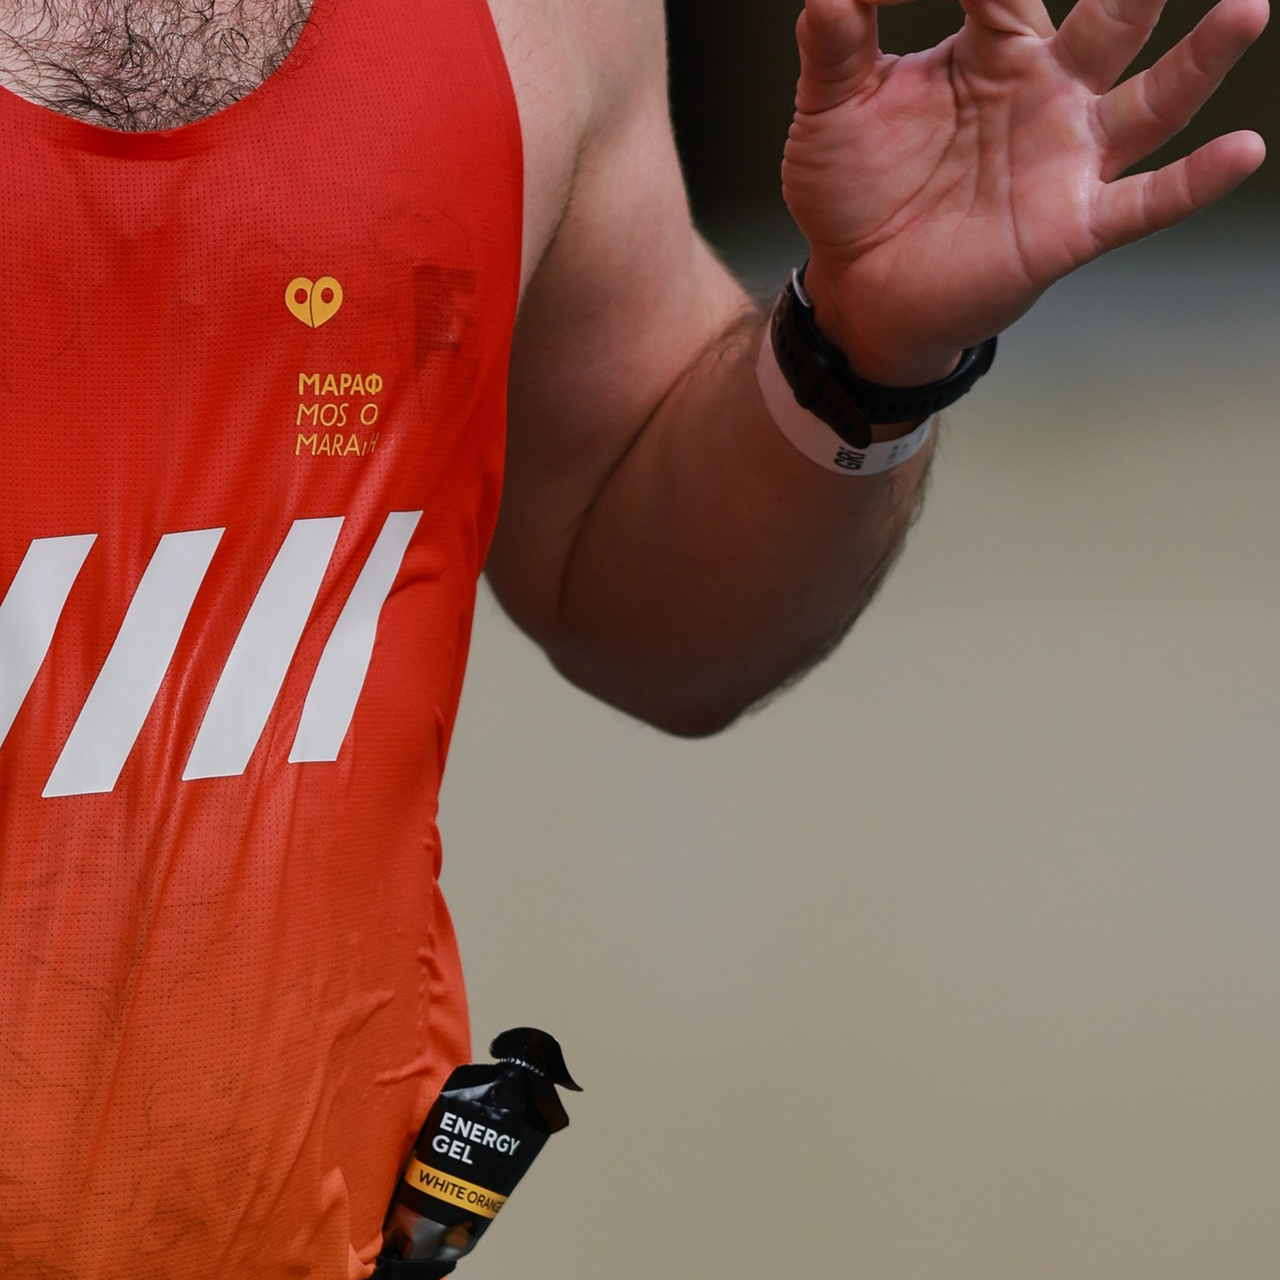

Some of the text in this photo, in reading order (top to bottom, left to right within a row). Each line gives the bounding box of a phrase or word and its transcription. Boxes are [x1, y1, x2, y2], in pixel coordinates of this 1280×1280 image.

[298, 373, 383, 396] МАРАФ
[439, 1111, 521, 1156] ENERGY
[431, 1134, 473, 1165] GEL
[419, 1169, 467, 1200] WHITE
